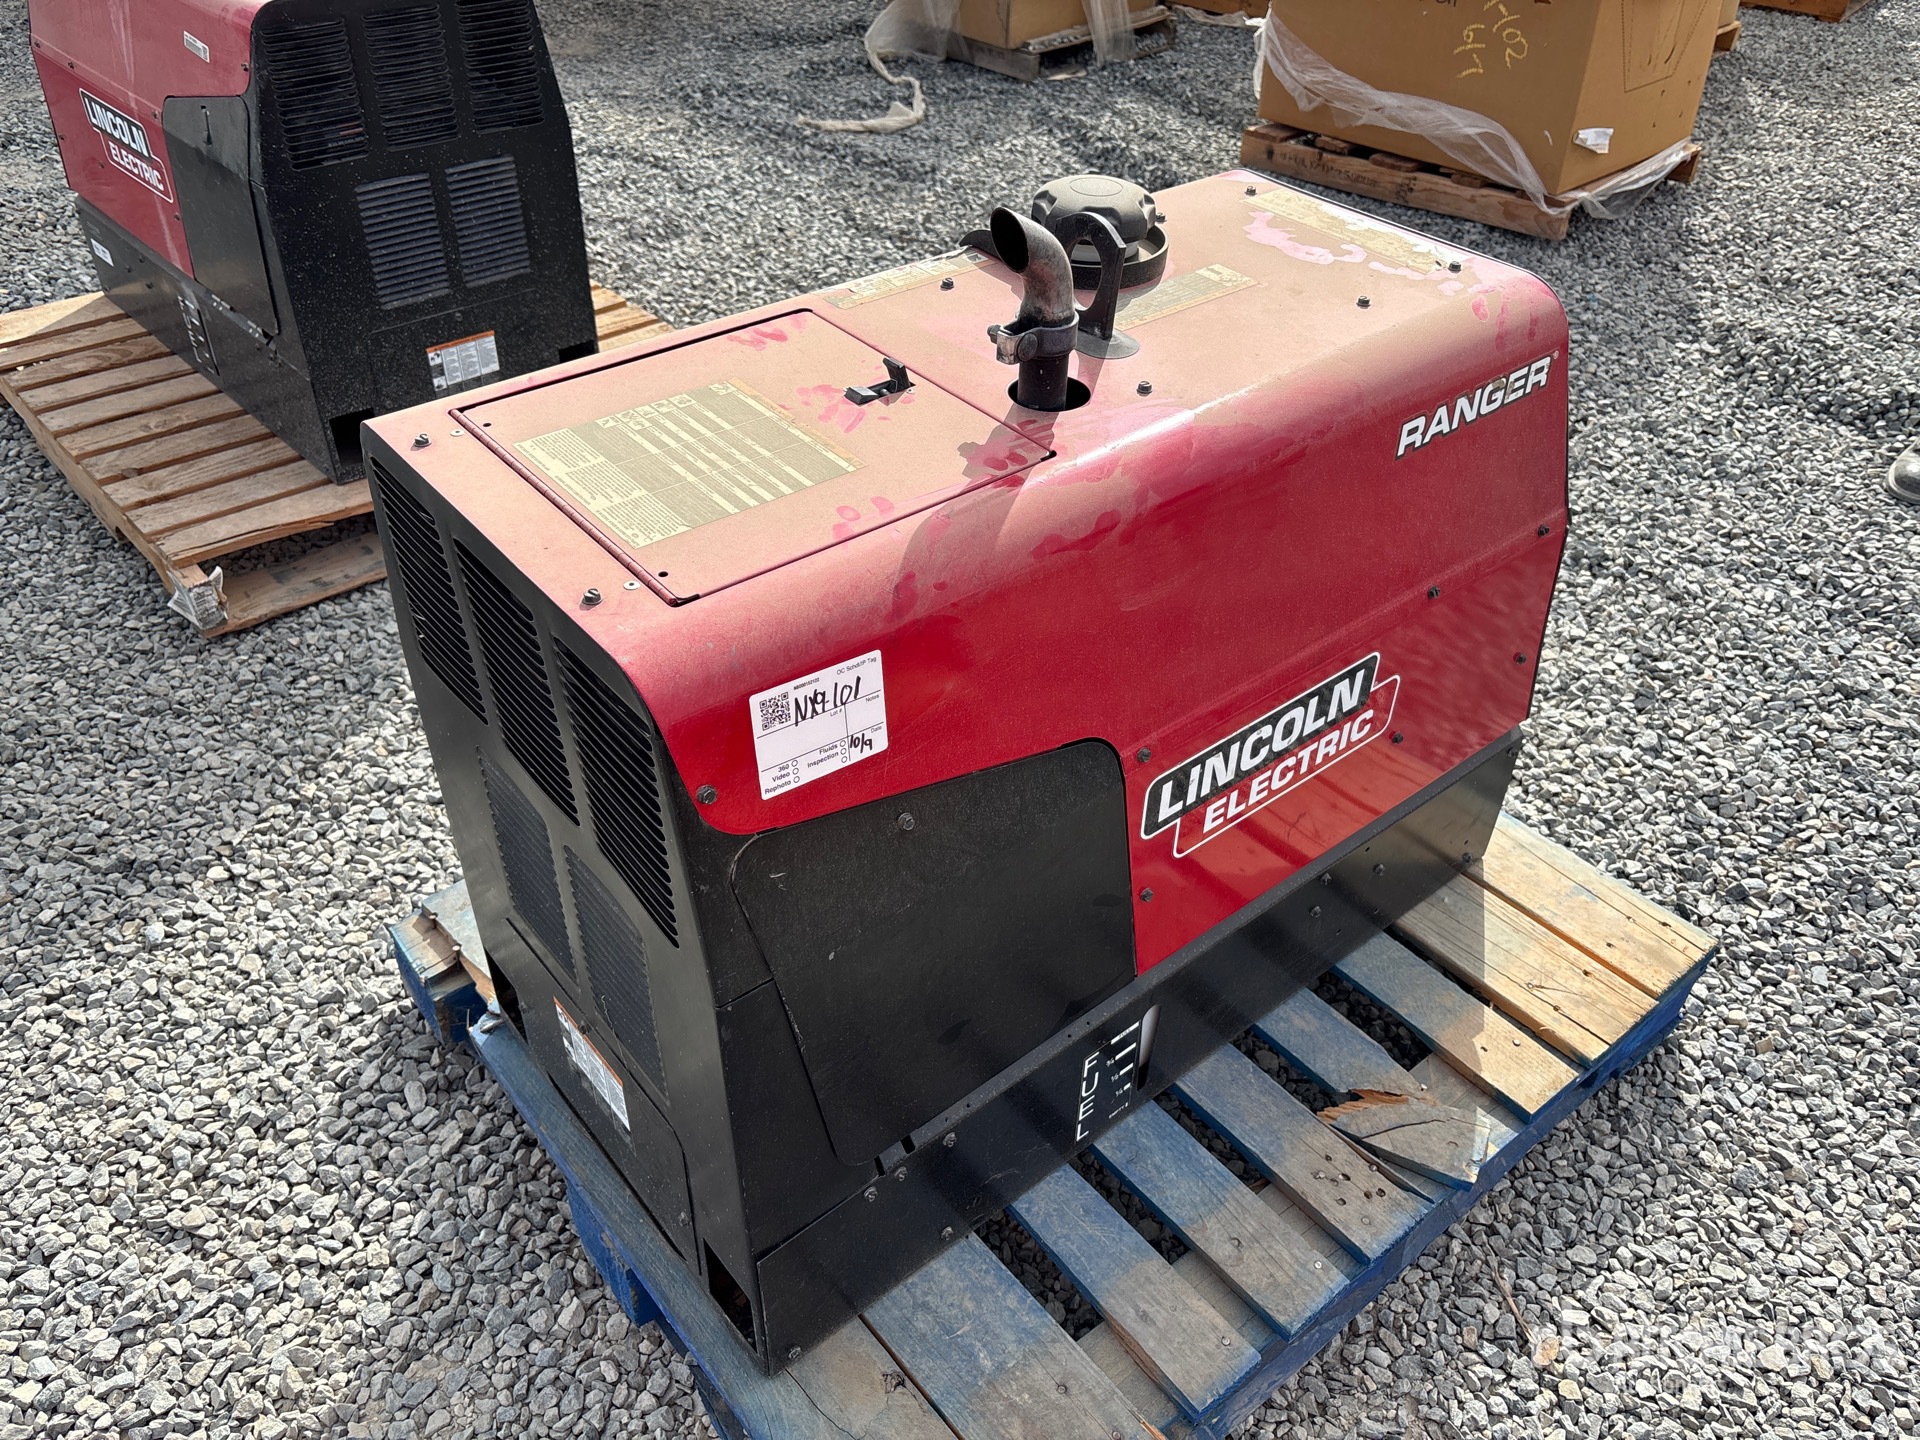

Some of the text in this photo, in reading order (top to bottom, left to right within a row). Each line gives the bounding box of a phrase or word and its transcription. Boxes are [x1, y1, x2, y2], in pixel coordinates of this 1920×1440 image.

[83, 96, 149, 158] LINCOLN
[107, 140, 165, 192] ELECTRIC
[1395, 355, 1552, 459] RANGER
[829, 709, 839, 717] Lot
[870, 725, 883, 734] Date
[819, 743, 839, 756] Fluids
[849, 732, 873, 754] 10/9
[1158, 668, 1365, 823] LINCOLN
[777, 763, 790, 773] 360
[807, 750, 840, 769] Inspection
[771, 771, 791, 783] Video
[1202, 709, 1375, 835] ELECTRIC
[763, 780, 792, 795] Rephoto
[1076, 1050, 1100, 1142] FUEL
